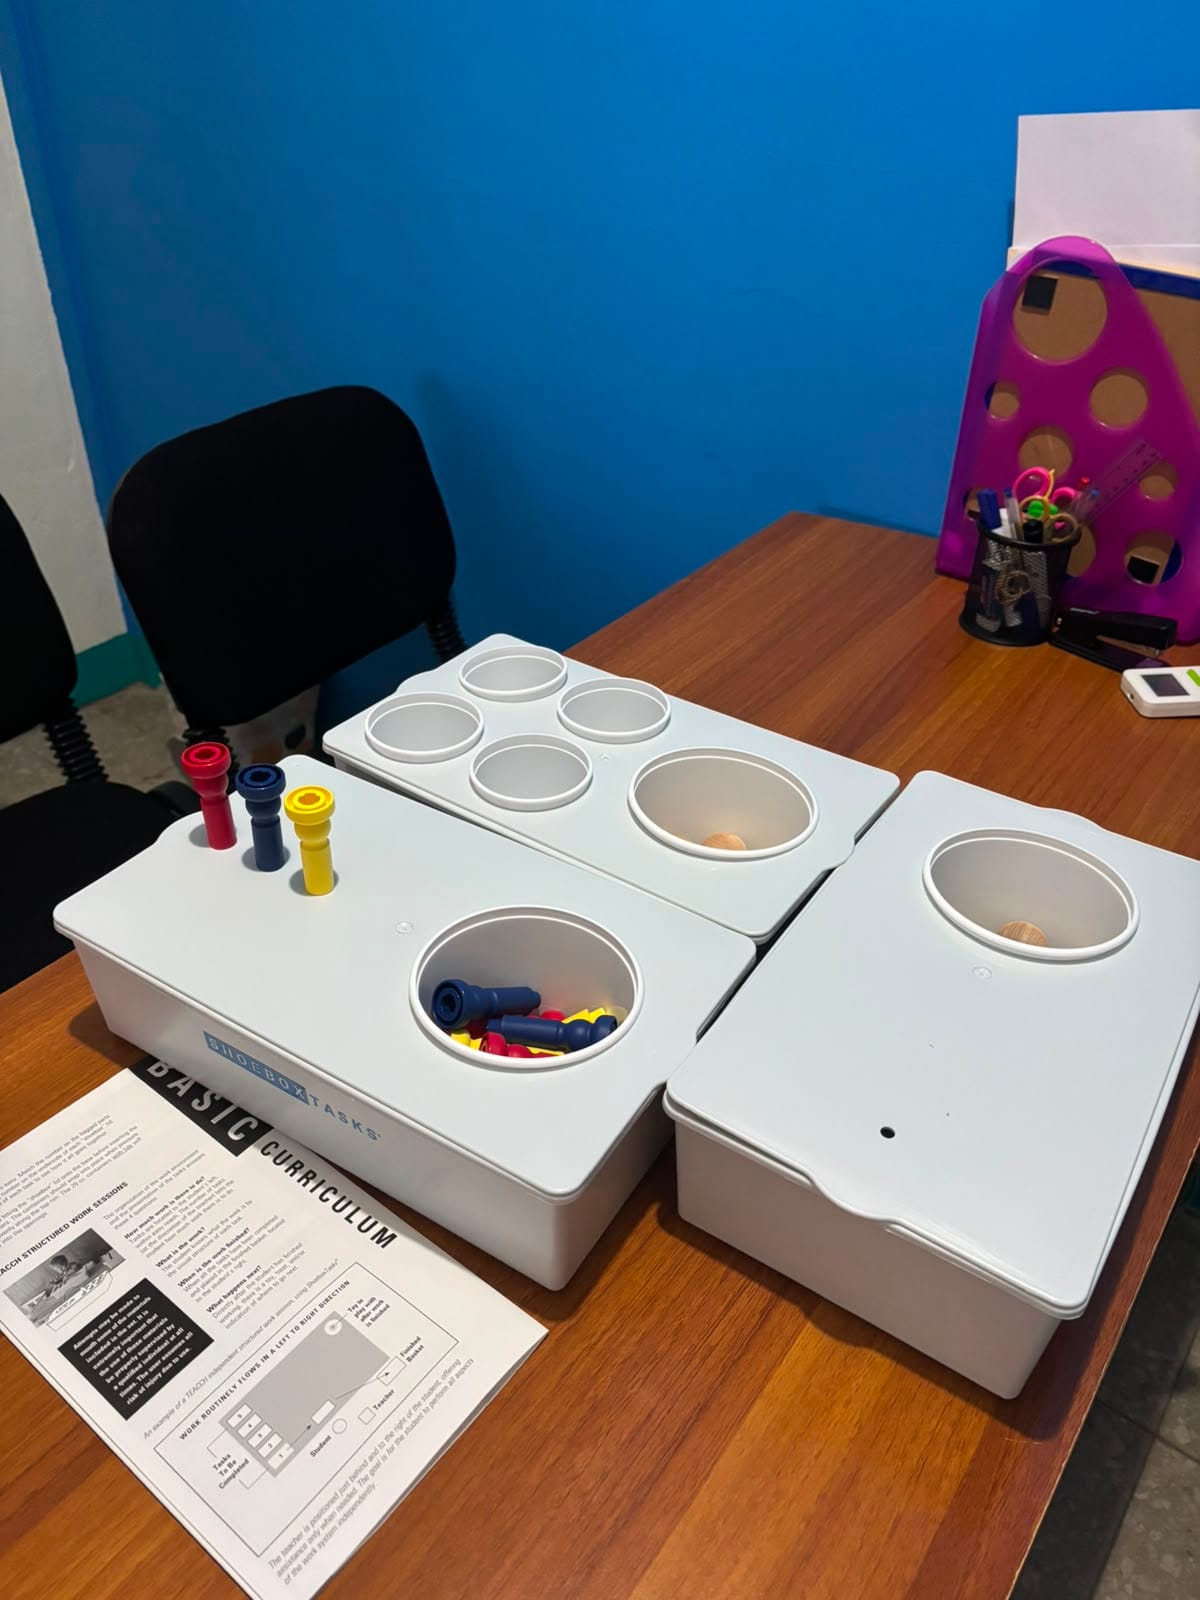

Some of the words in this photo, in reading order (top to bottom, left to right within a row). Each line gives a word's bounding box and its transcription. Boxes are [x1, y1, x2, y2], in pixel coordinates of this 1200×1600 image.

[147, 1060, 258, 1141] BASIC
[261, 1141, 398, 1248] CURRICULUM
[124, 1228, 138, 1239] How
[139, 1215, 154, 1228] much
[154, 1204, 168, 1216] work
[174, 1188, 189, 1200] there
[194, 1176, 205, 1184] do?
[22, 1223, 70, 1259] STRUCTURED
[70, 1207, 93, 1225] WORK
[93, 1181, 128, 1208] SESSIONS
[156, 1254, 172, 1267] What
[188, 1226, 205, 1241] work?
[178, 1272, 196, 1286] When
[212, 1247, 226, 1259] work
[225, 1227, 250, 1247] finished?
[207, 1298, 223, 1312] What
[222, 1278, 246, 1299] happens
[246, 1265, 261, 1279] next?
[347, 1304, 358, 1312] Toy
[355, 1308, 365, 1318] play
[365, 1296, 375, 1306] with
[360, 1311, 371, 1322] after
[371, 1299, 383, 1311] work
[370, 1304, 389, 1322] finished
[400, 1336, 420, 1356] Finished
[406, 1344, 424, 1362] Basket
[179, 1419, 200, 1439] WORK
[201, 1384, 237, 1418] ROUTINELY
[238, 1362, 260, 1383] FLOWS
[275, 1334, 290, 1348] LEFT
[300, 1308, 318, 1325] RIGHT
[318, 1280, 349, 1308] DIRECTION
[373, 1389, 394, 1410] Teacher
[310, 1434, 331, 1456] Student
[213, 1453, 230, 1470] Tasks
[218, 1458, 249, 1489] Completed
